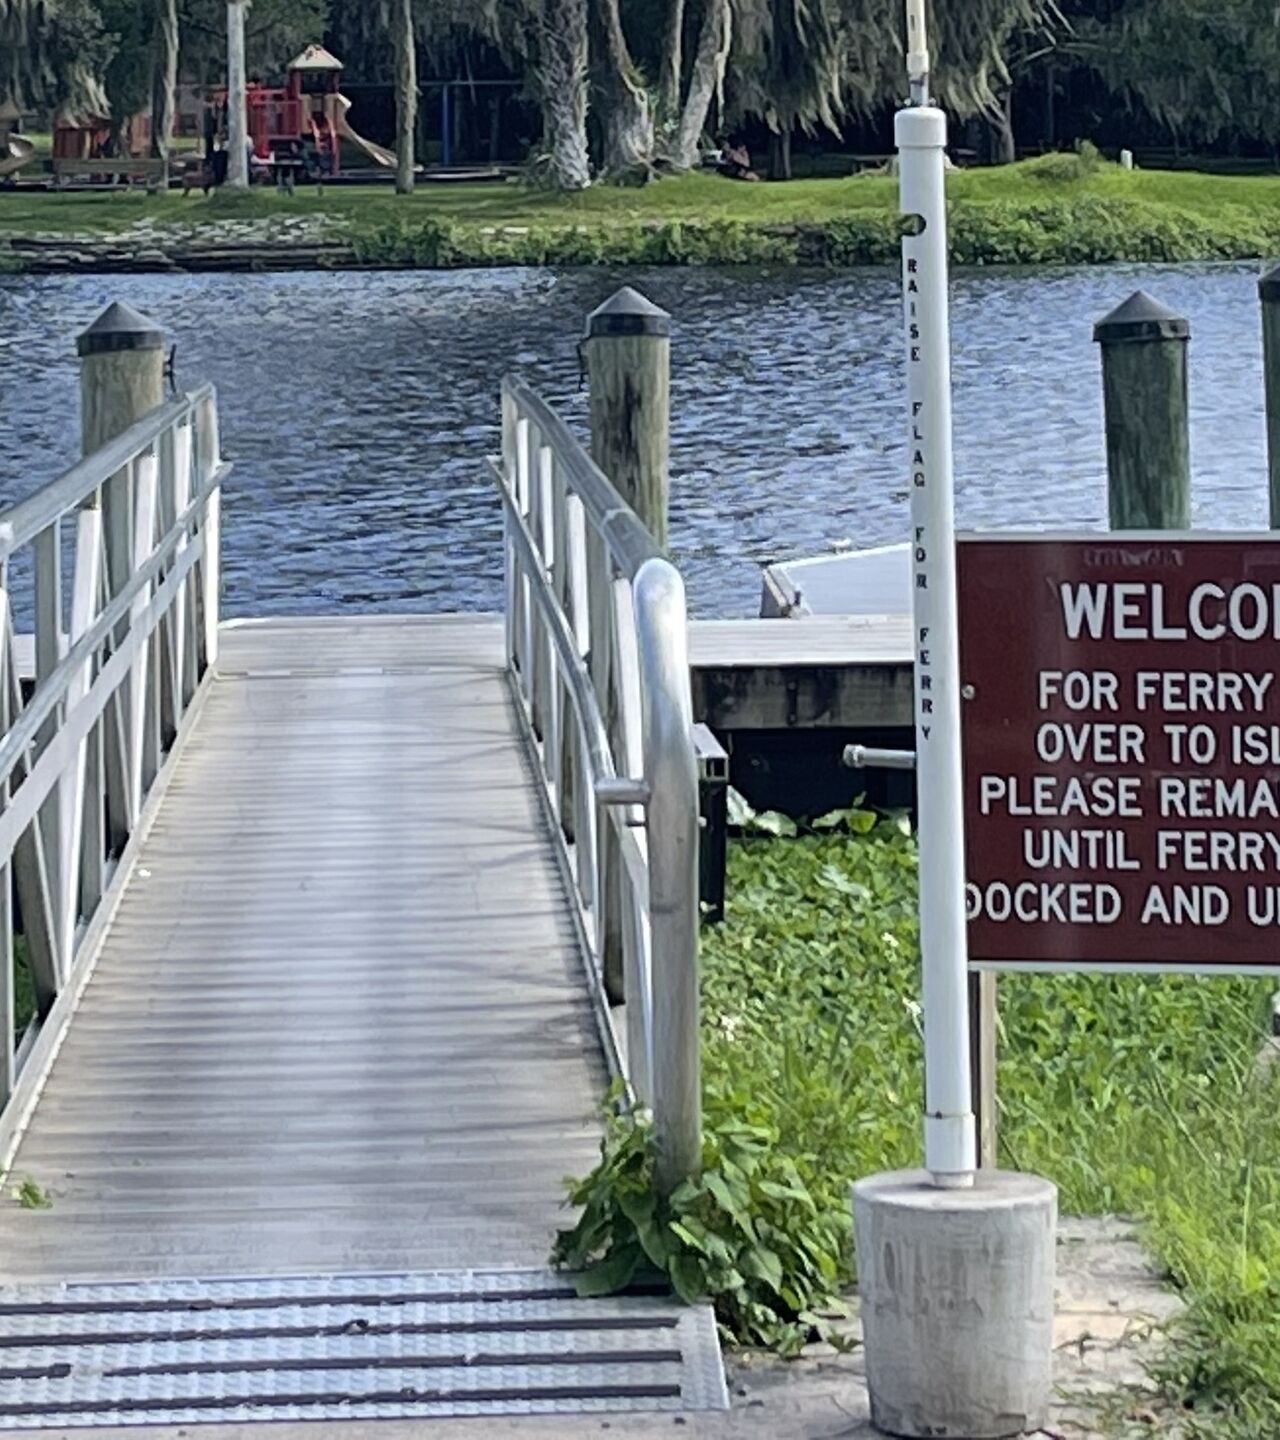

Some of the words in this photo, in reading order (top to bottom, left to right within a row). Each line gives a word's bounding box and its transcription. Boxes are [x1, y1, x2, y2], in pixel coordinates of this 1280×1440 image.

[906, 258, 921, 362] RAISE
[911, 401, 926, 488] FLAG
[915, 526, 928, 590] FOR
[919, 627, 934, 741] FERRY
[1039, 671, 1118, 711] FOR
[1137, 672, 1273, 711] FERRY
[1036, 723, 1145, 763] OVER
[1163, 724, 1217, 763] TO
[980, 776, 1143, 816] PLEASE
[1024, 829, 1141, 869] UNTIL
[1141, 884, 1230, 924] AND
